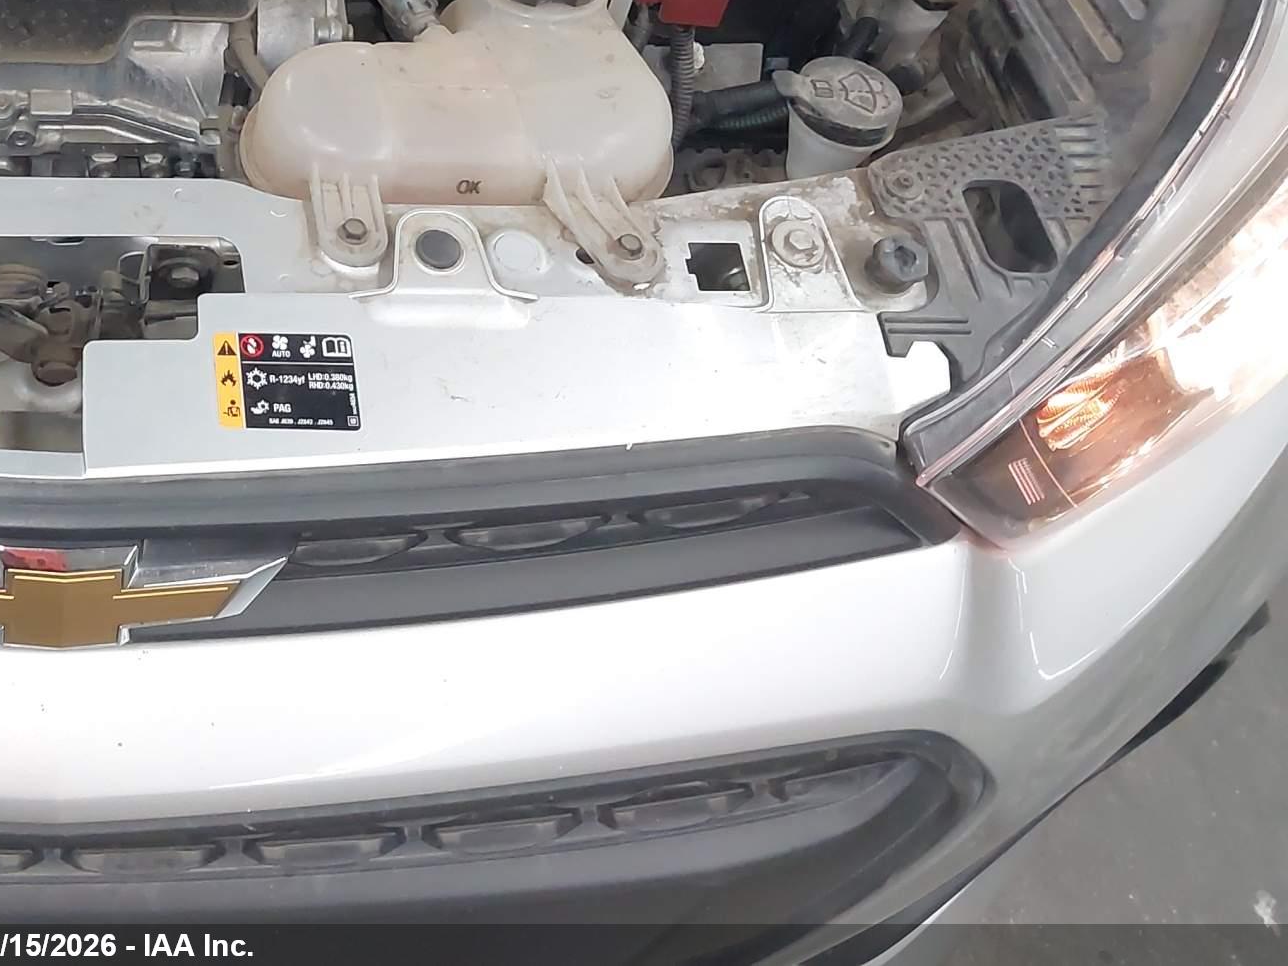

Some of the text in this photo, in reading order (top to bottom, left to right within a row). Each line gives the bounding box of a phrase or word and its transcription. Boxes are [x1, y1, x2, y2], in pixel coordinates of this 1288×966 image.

[456, 179, 482, 195] OK
[272, 350, 291, 358] AUTO
[269, 374, 306, 386] R-1234yf
[273, 403, 292, 413] PAG
